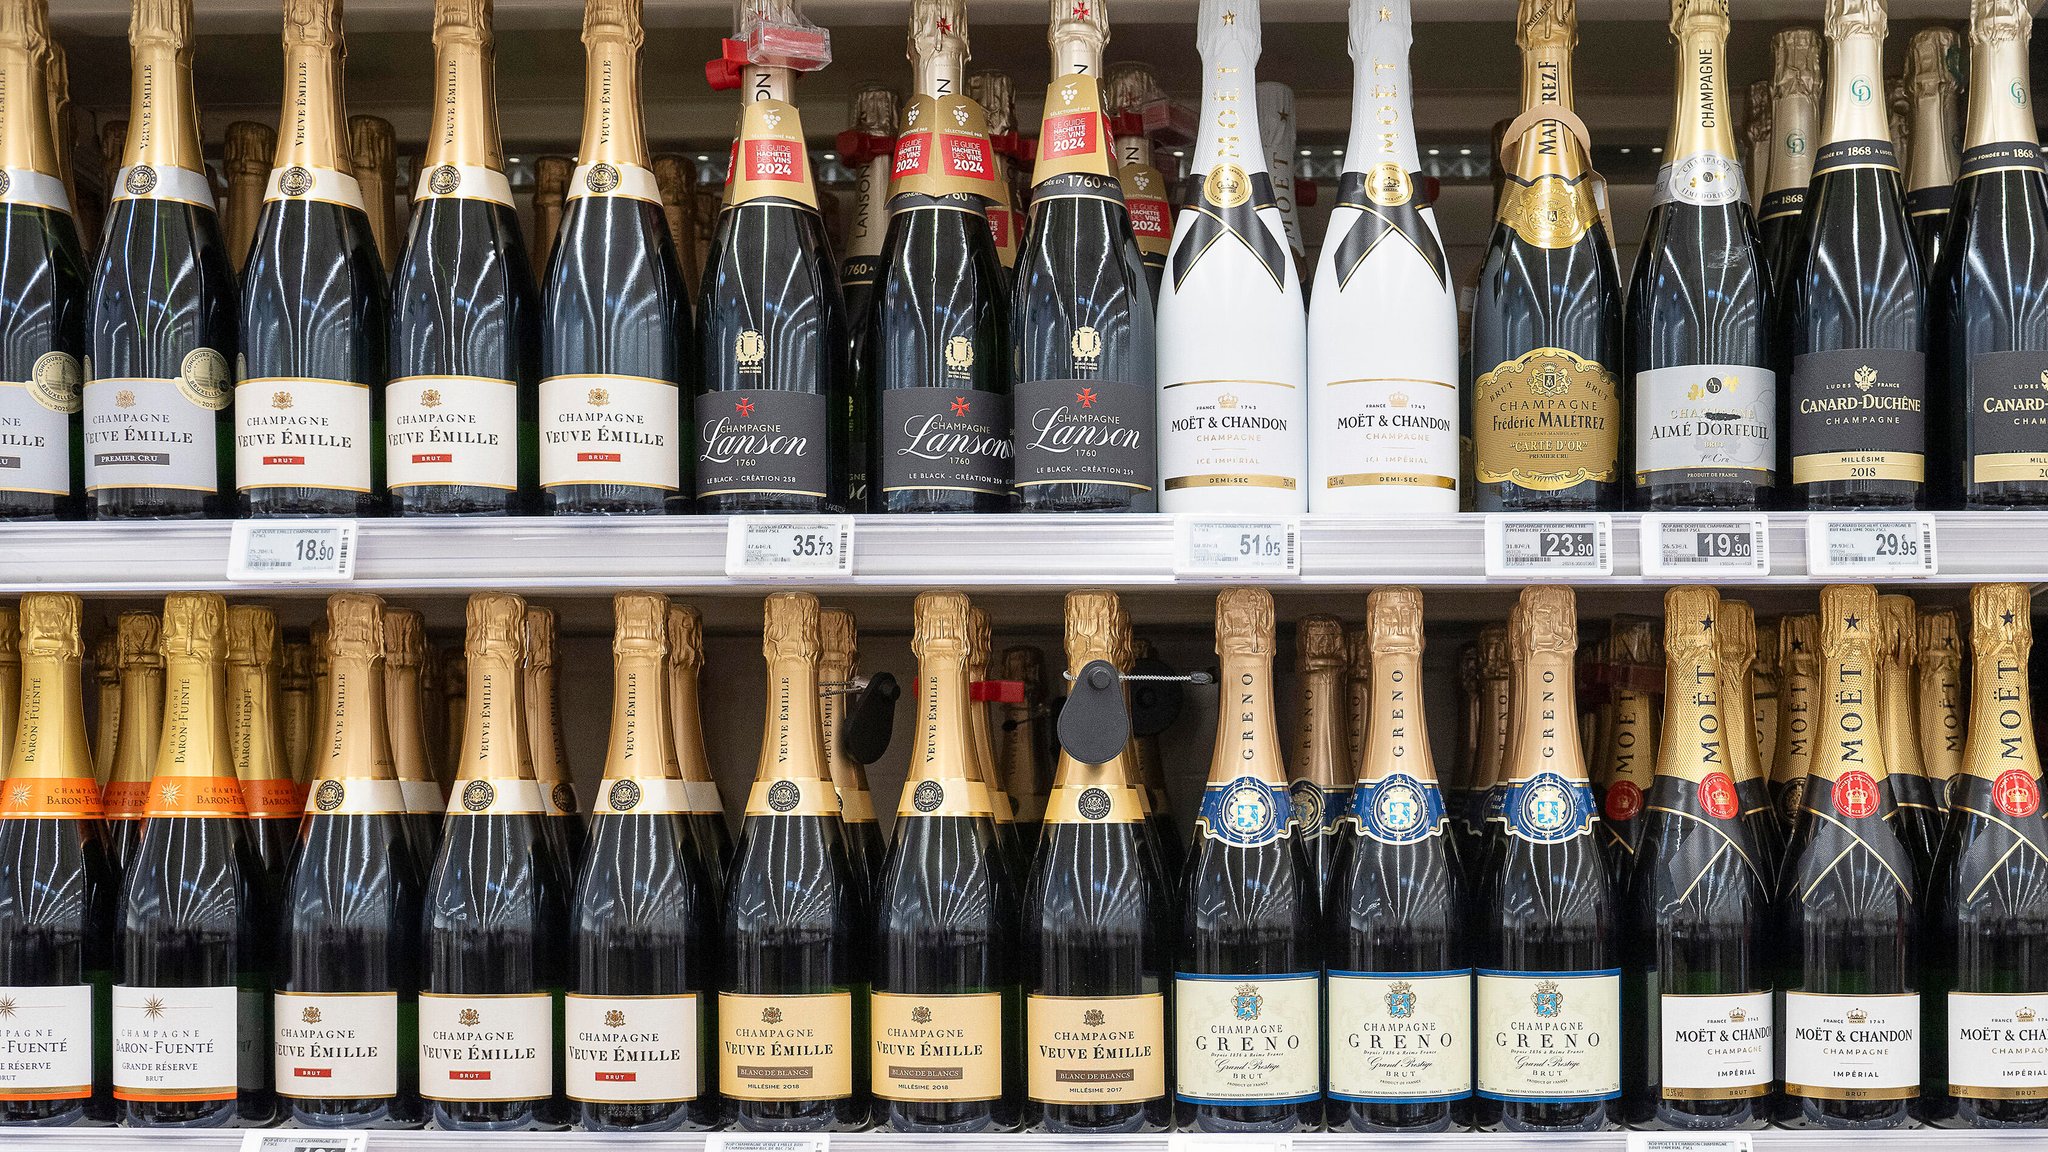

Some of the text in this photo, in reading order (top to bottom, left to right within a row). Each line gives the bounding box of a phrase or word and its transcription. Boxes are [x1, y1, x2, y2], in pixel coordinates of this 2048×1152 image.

[1699, 48, 1715, 128] CHAMPAGNE
[446, 59, 457, 146] VEUVE ÉMILLE
[1054, 125, 1086, 134] HACHETTE
[1063, 118, 1086, 128] GUIDE
[1068, 130, 1086, 139] VINS
[952, 147, 982, 156] HACHETTE
[960, 141, 980, 149] GUIDE
[1053, 139, 1086, 152] 2024
[1847, 146, 1872, 156] 1868
[756, 151, 792, 159] HACHETTE
[966, 153, 983, 162] VINS
[2013, 148, 2034, 159] 1868
[757, 163, 792, 176] 2024
[953, 159, 984, 174] 2024
[1067, 174, 1102, 189] 1760
[1781, 194, 1804, 204] 1868
[187, 353, 211, 373] CONCOURS
[42, 383, 74, 402] BRUXELLES
[189, 381, 221, 398] BRUXELLES
[1490, 381, 1514, 403] BRUT
[1585, 381, 1609, 401] BRUT
[1500, 400, 1598, 412] CHAMPAGNE
[1800, 393, 1921, 415] CANARD-DUCHÊNE
[247, 415, 329, 428] CHAMPAGNE
[397, 413, 477, 425] CHAMPAGNE
[559, 413, 645, 425] CHAMPAGNE
[1171, 415, 1288, 433] MOËT & CHANDON
[1337, 413, 1451, 432] MOËT & CHANDON
[1493, 409, 1605, 431] Frédéric MALÉTREZ
[1826, 415, 1901, 426] CHAMPAGNE
[86, 425, 193, 445] VEUVE ÉMILLE
[897, 413, 1008, 460] Lanson
[1025, 405, 1140, 453] Lanson
[1650, 420, 1769, 441] AIMÉ DORFEUIL
[238, 427, 352, 449] VEUVE ÉMILLE
[699, 416, 807, 464] Lanson
[100, 453, 158, 465] PREMIER CRU
[1075, 449, 1097, 457] 1760
[1841, 455, 1885, 464] MILLÉSIME
[735, 458, 756, 467] 1760
[949, 457, 970, 465] 1760
[706, 477, 713, 485] LE
[713, 476, 733, 484] BLACK
[741, 474, 780, 483] CRÉATION
[920, 472, 946, 480] BLACK
[955, 473, 991, 484] CRÉATION
[1850, 467, 1877, 478] 2018
[332, 673, 346, 759] VEUVE ÉMILLE
[1241, 672, 1254, 760] GRENO
[1391, 669, 1405, 757] GRENO
[1542, 670, 1555, 758] GRENO
[1693, 664, 1722, 764] MOËT
[1835, 663, 1864, 764] MOËT
[1993, 660, 2024, 761] MOËT
[25, 677, 42, 763] BARON-FUENTÉ
[174, 678, 190, 764] BARON-FUENTÉ
[121, 1029, 200, 1038] CHAMPAGNE
[281, 1028, 356, 1039] CHAMPAGNE
[433, 1030, 515, 1041] CHAMPAGNE
[1348, 1032, 1453, 1050] GRENO
[1495, 1031, 1601, 1049] GRENO
[1675, 1028, 1717, 1043] MOËT
[1720, 1030, 1729, 1042] &
[1795, 1026, 1913, 1043] MOËT & CHANDON
[1959, 1026, 2015, 1042] MOËT &
[116, 1038, 214, 1054] BARON-FUENTÉ
[310, 1042, 378, 1058] ÉMILLE
[1195, 1034, 1300, 1052] GRENO
[422, 1044, 536, 1061] VEUVE ÉMILLE
[569, 1045, 681, 1063] VEUVE ÉMILLE
[8, 1060, 52, 1071] RÉSERVE
[122, 1060, 198, 1071] GRANDE RÉSERVE
[1215, 1058, 1282, 1073] Grand Prestige
[1367, 1056, 1434, 1070] Grand Prestige
[740, 1068, 763, 1076] BLANC
[776, 1068, 809, 1077] BLANCS
[1717, 1067, 1756, 1078] IMPÉRIAL
[1833, 1068, 1879, 1078] IMPÉRIAL
[747, 1082, 781, 1090] MILLÉSIME
[898, 1083, 931, 1091] MILLÉSIME
[1069, 1085, 1104, 1094] MILLÉSIME
